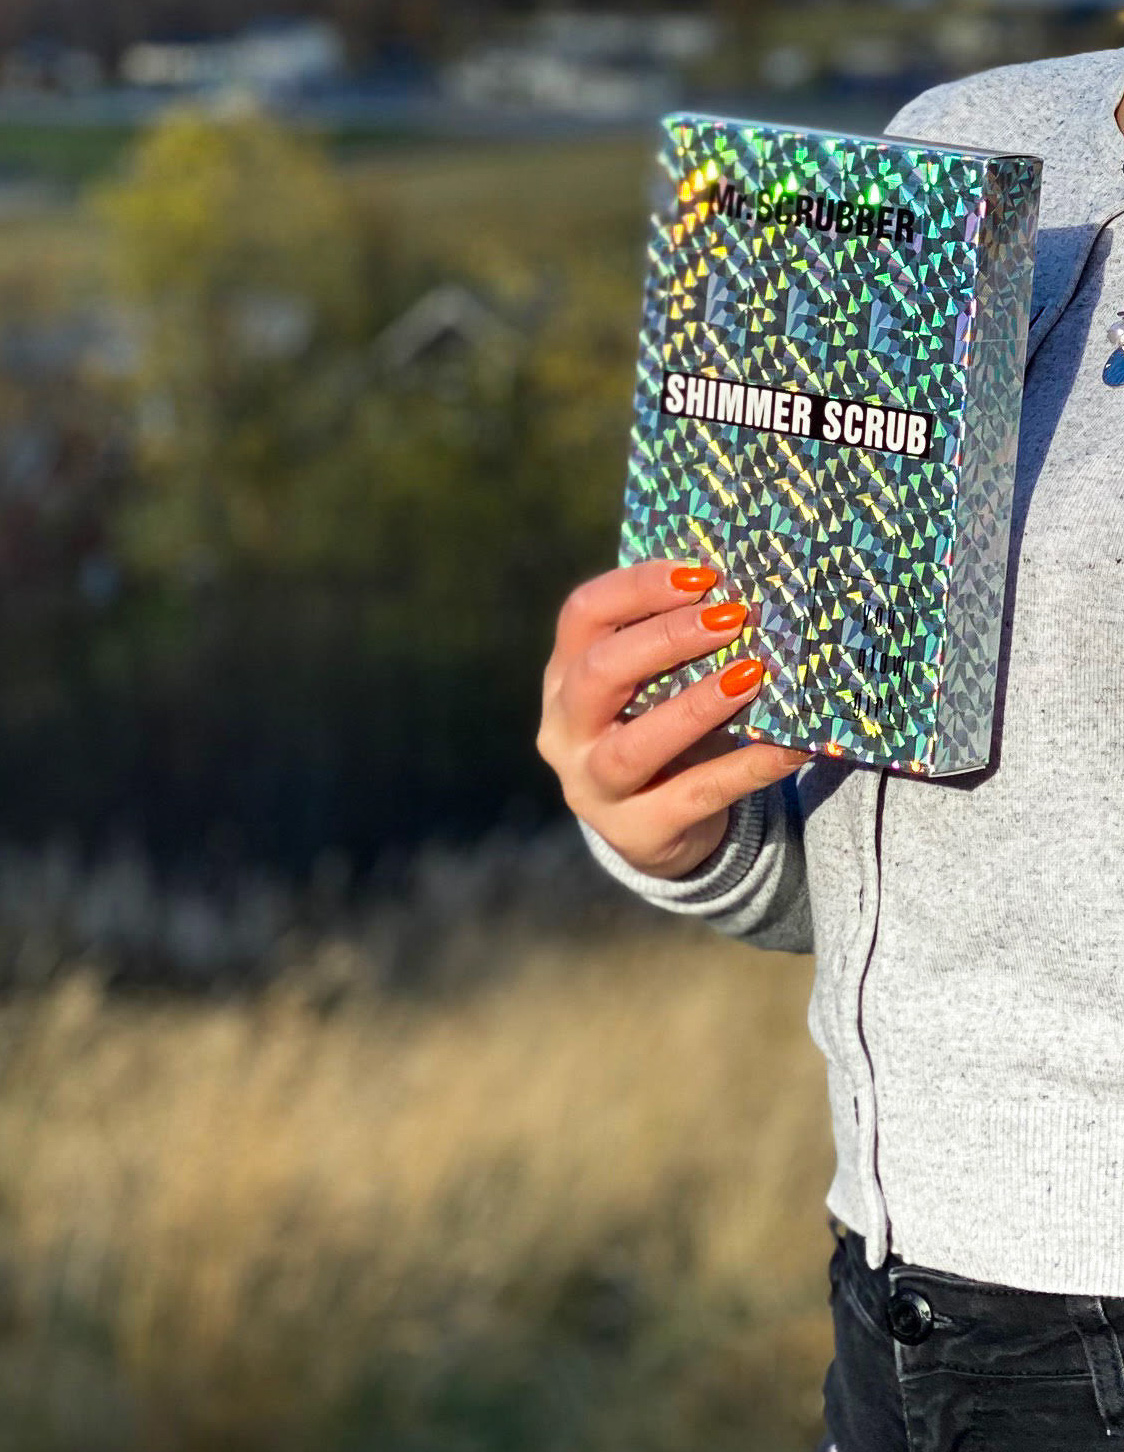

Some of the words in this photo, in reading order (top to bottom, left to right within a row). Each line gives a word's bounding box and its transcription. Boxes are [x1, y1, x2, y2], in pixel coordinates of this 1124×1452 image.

[710, 182, 915, 243] Mr.SCRUBBER
[664, 374, 811, 436] SHIMMER
[822, 400, 928, 455] SCRUB
[863, 604, 896, 631] you
[858, 645, 905, 676] glow
